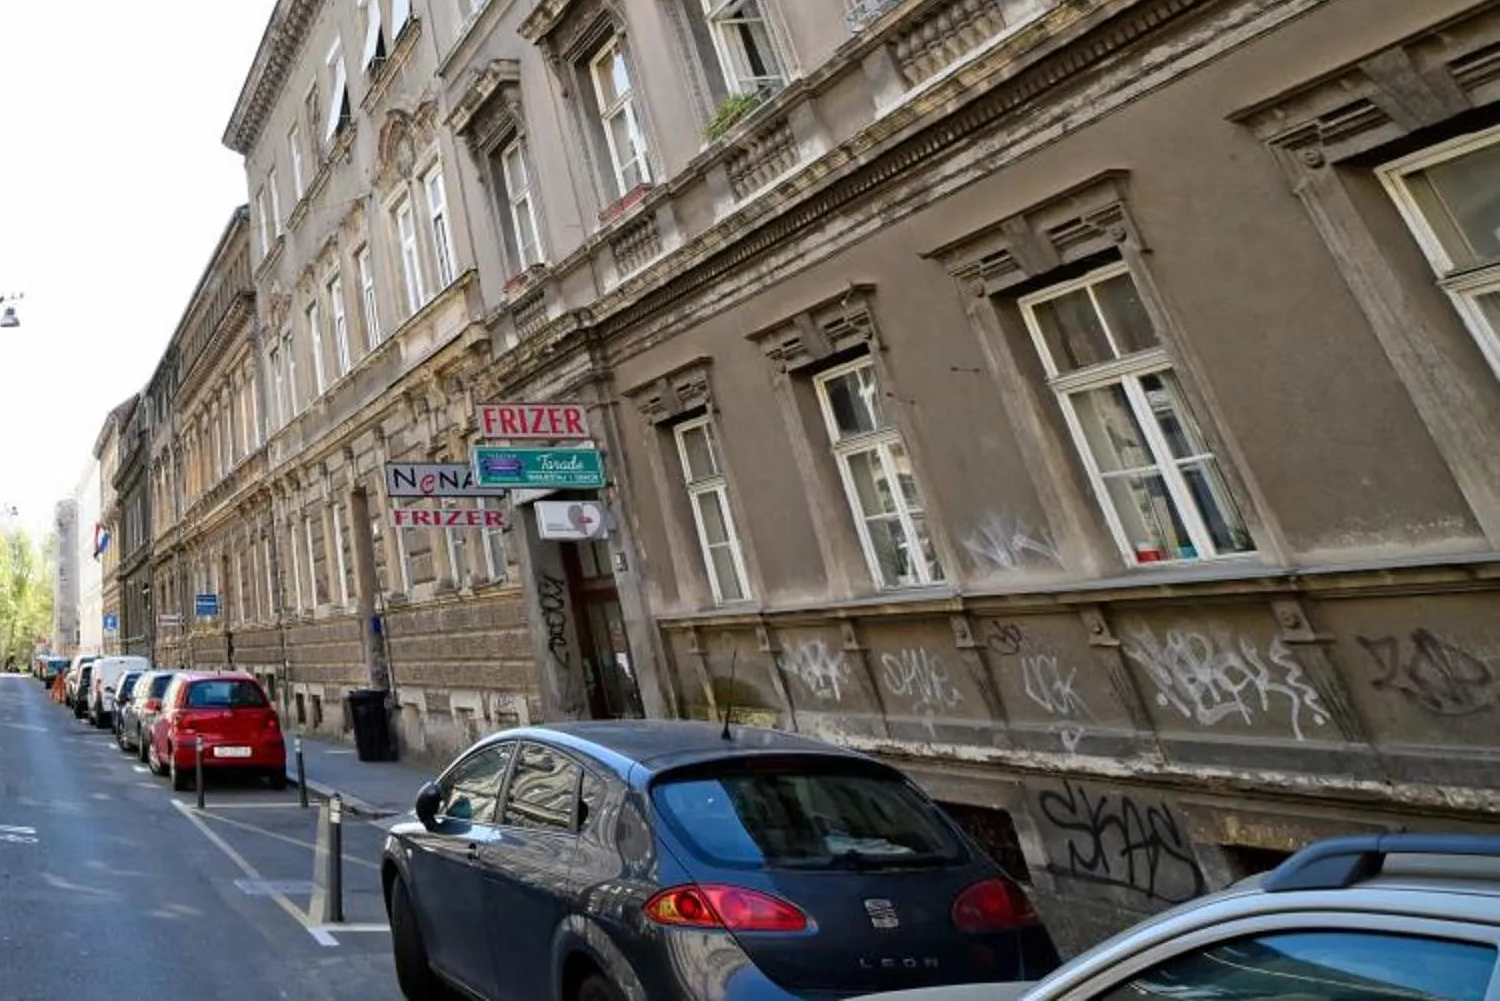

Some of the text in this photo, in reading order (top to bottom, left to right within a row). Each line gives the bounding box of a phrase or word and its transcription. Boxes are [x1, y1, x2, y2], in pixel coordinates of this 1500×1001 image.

[483, 407, 584, 433] FRIZER
[394, 510, 504, 526] FRIZER
[859, 957, 939, 968] LEON
